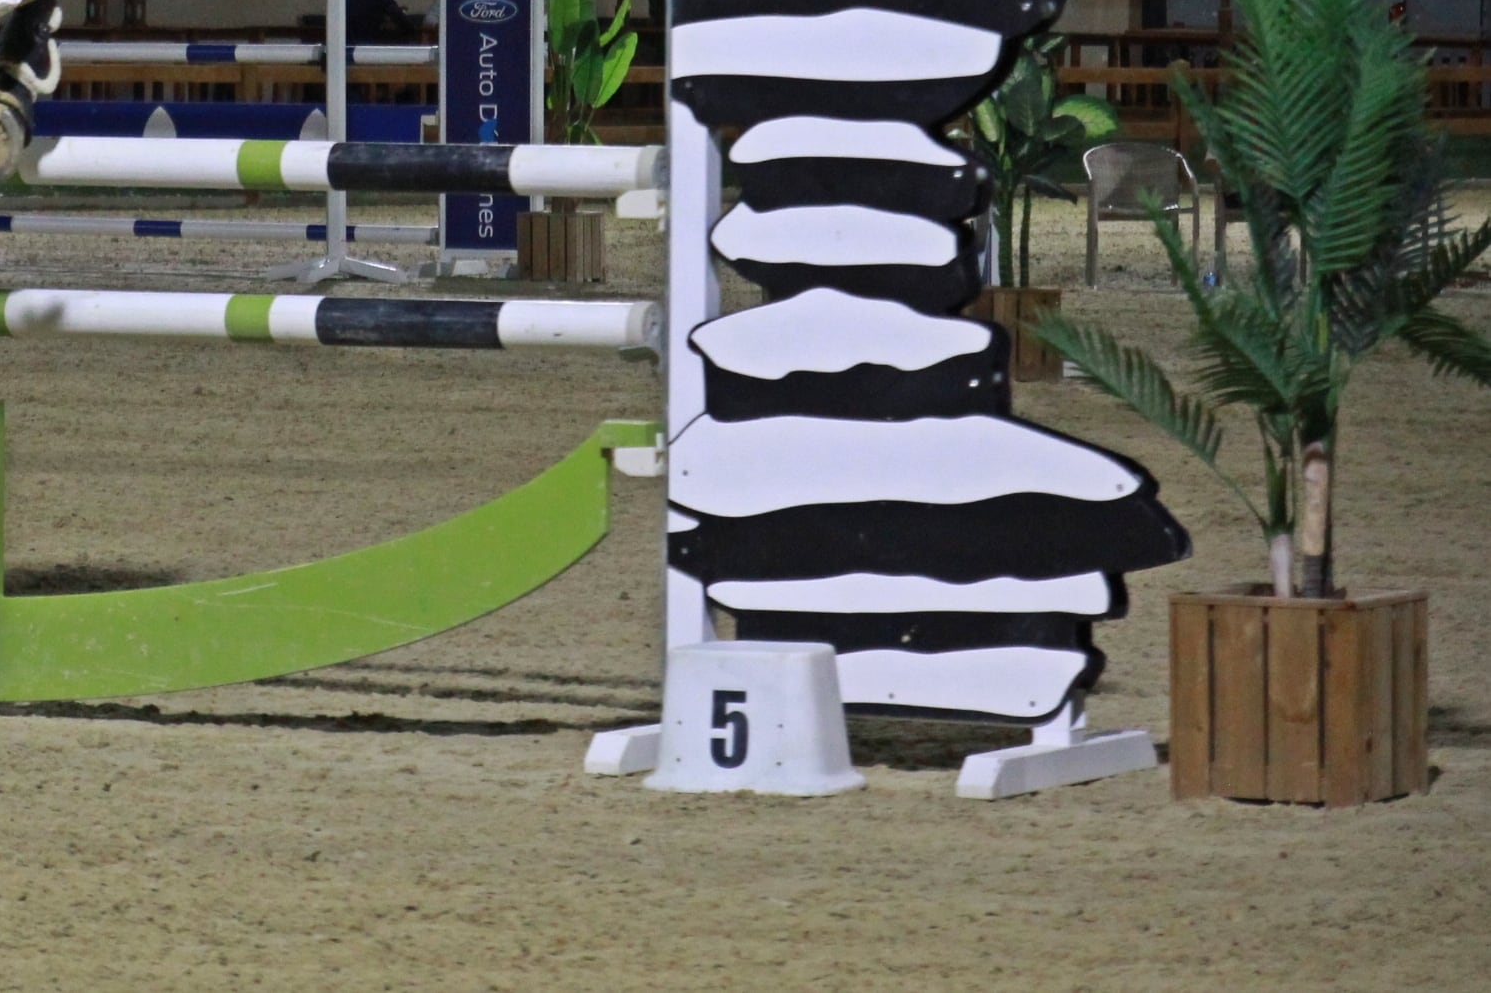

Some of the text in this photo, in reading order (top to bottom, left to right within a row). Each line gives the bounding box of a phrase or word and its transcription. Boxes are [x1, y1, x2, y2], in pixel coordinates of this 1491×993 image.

[469, 1, 506, 19] Ford
[478, 32, 498, 96] Auto
[711, 690, 749, 768] 5
